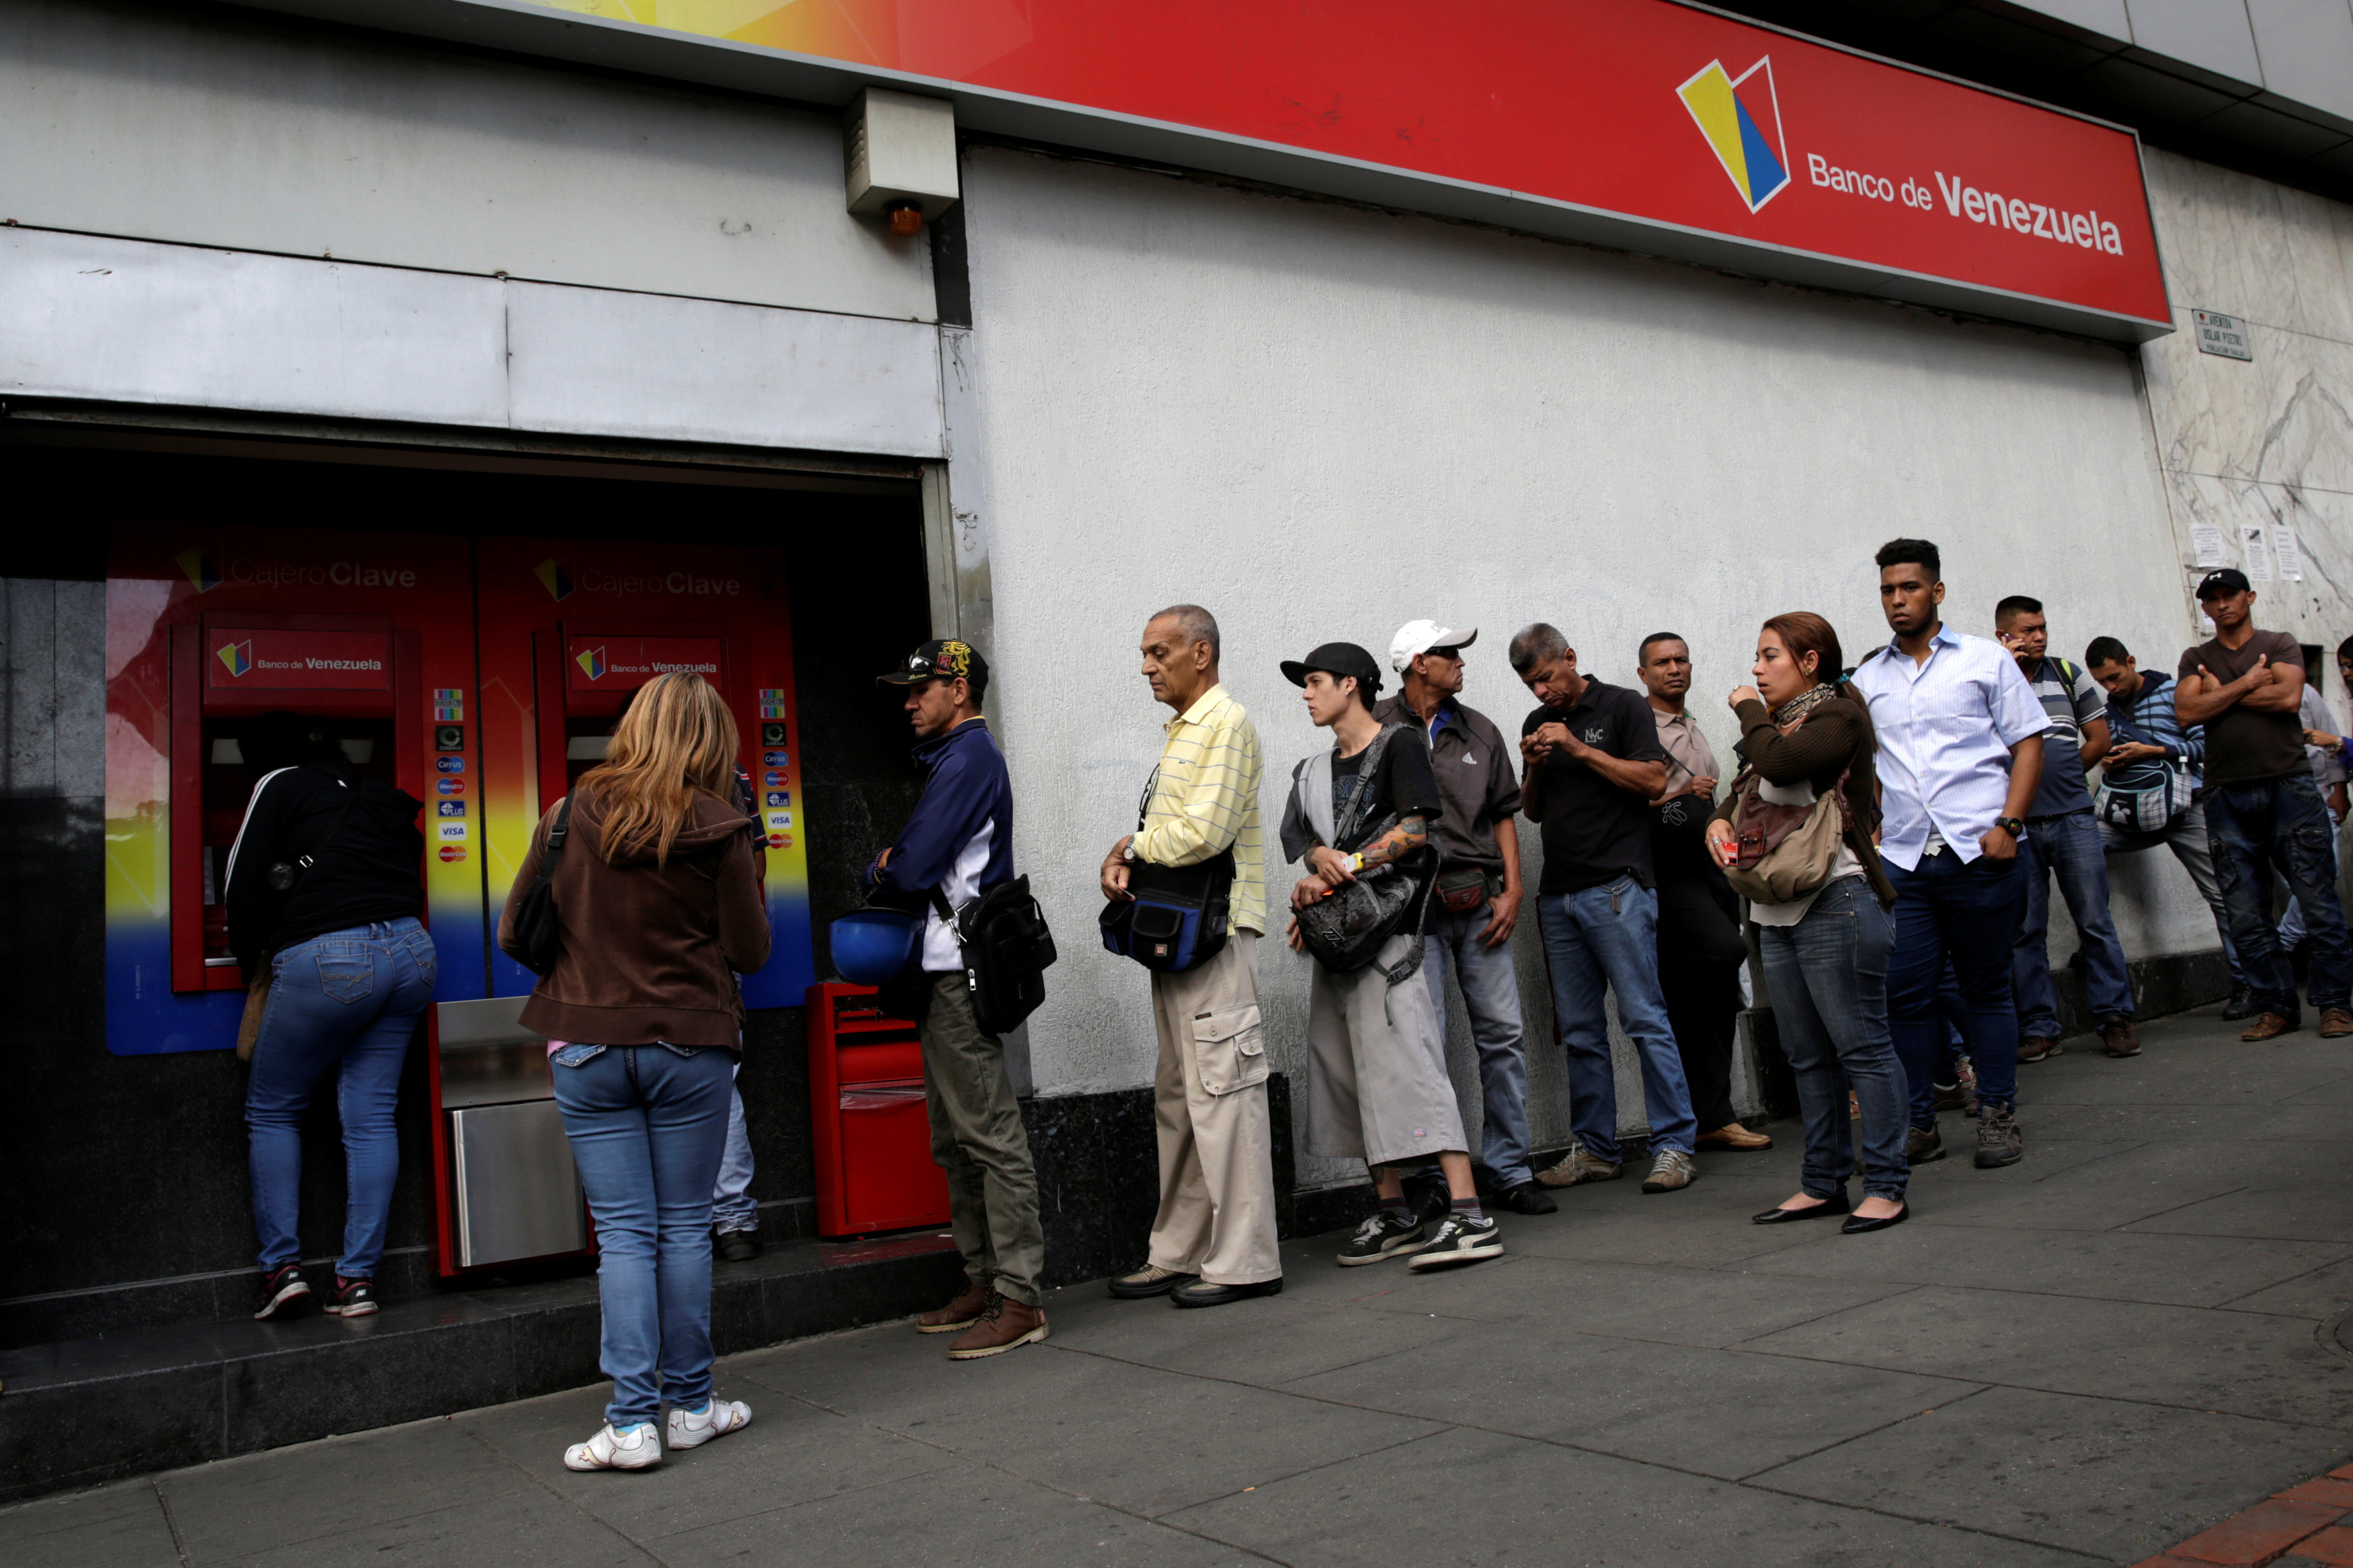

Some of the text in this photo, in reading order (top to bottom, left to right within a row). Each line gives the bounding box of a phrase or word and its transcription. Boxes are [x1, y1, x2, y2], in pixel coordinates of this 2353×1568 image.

[1807, 153, 2124, 255] Banco de Venezuela
[258, 657, 382, 670] Banco de Venezuela
[611, 661, 717, 673] Banco de Venezuela
[1585, 728, 1603, 743] NYC
